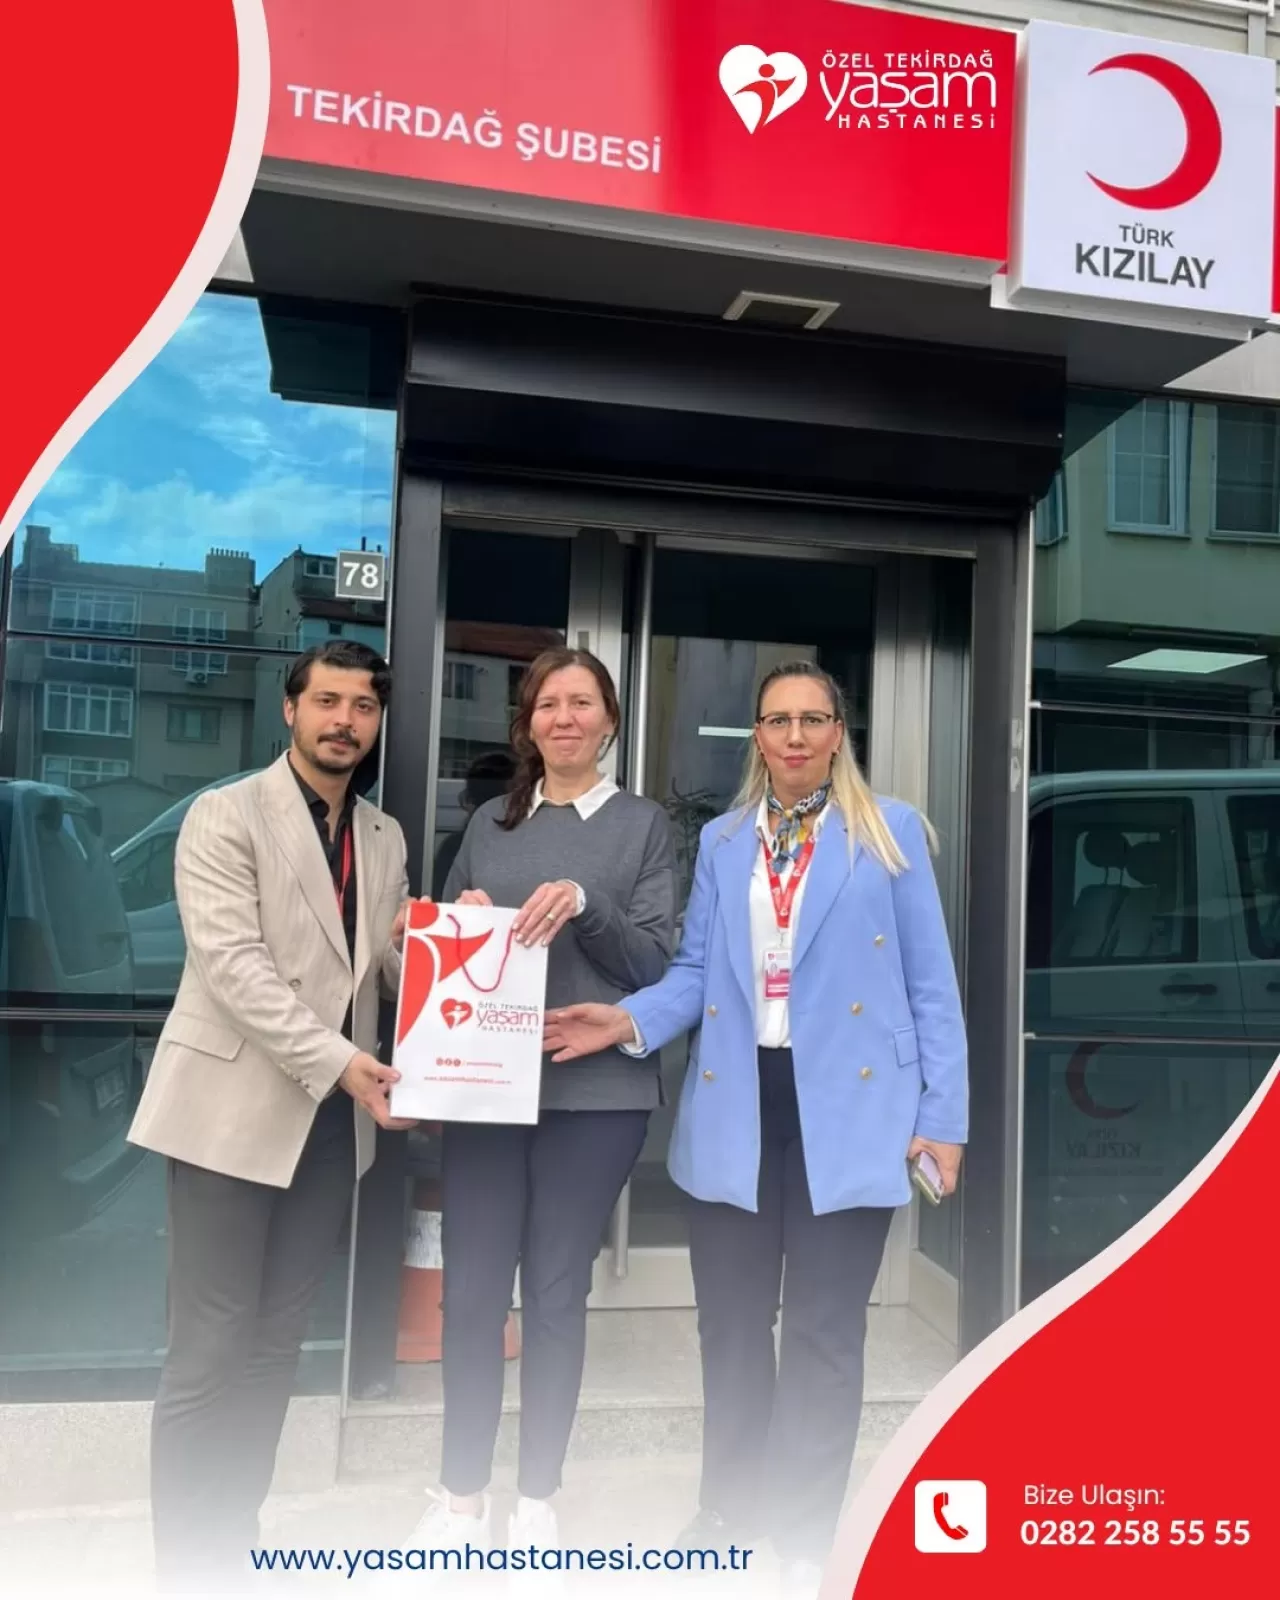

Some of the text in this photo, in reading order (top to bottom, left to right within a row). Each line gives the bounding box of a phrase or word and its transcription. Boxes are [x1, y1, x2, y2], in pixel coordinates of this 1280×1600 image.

[287, 85, 663, 174] TEKİRDAĞ ŞUBESİ
[1118, 222, 1175, 248] TÜRK
[1075, 243, 1215, 289] KIZILAY
[342, 562, 379, 588] 78
